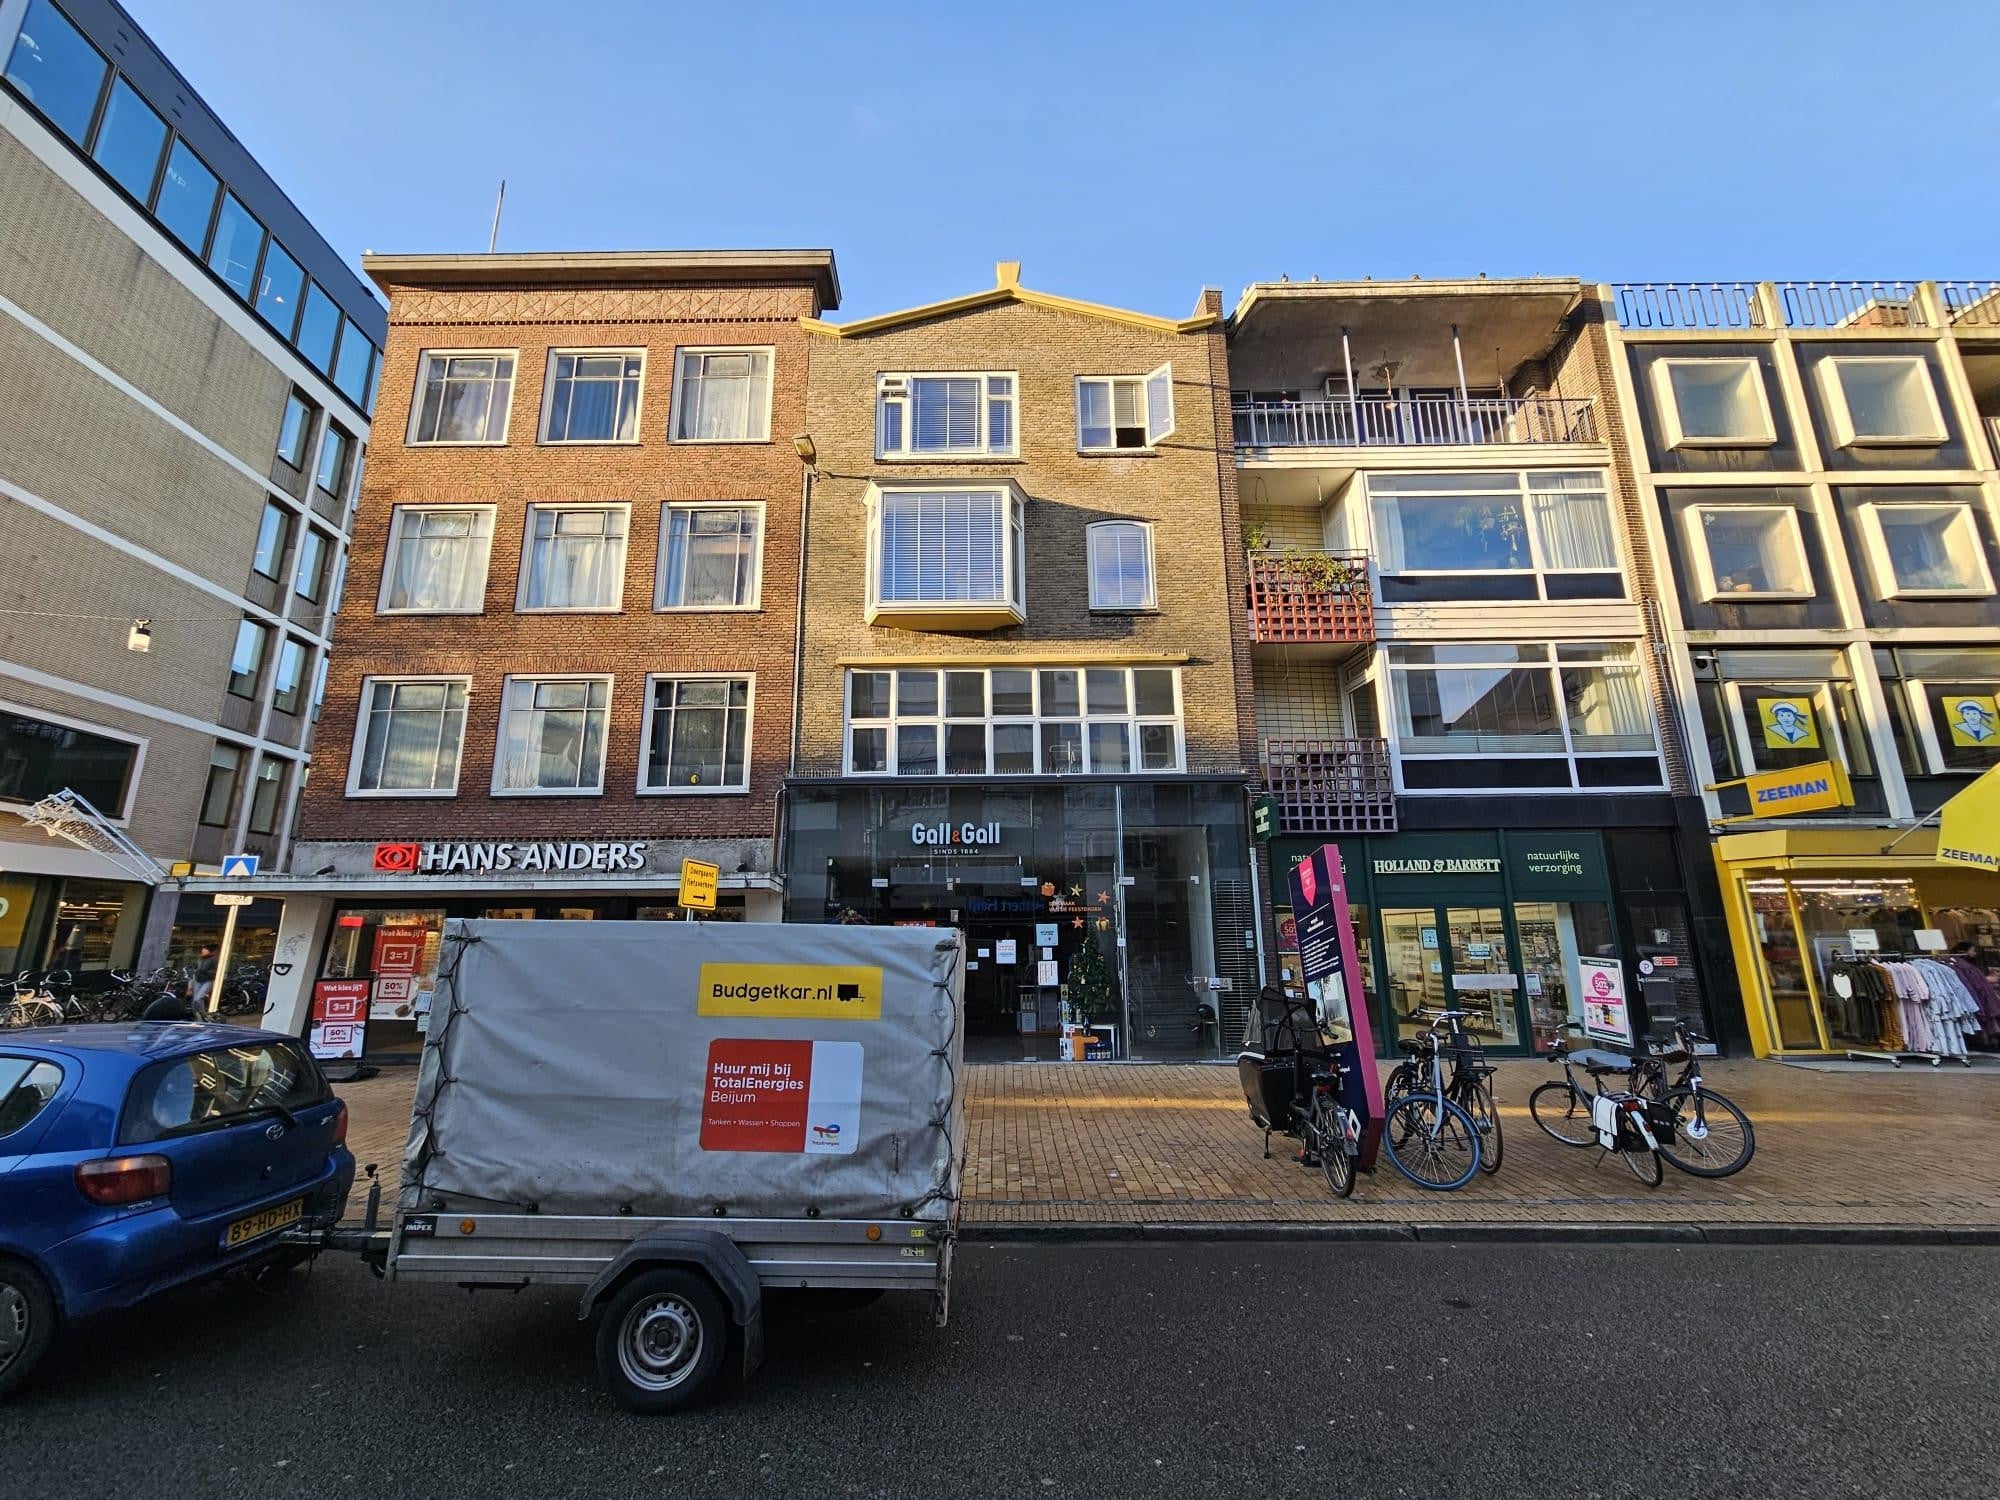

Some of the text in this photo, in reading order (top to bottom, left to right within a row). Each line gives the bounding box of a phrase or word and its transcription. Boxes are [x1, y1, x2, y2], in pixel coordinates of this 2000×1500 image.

[1756, 779, 1828, 803] ZEEMAN
[427, 843, 646, 870] HANS ANDERS
[1527, 851, 1580, 862] natuurlijke
[1374, 859, 1501, 874] HOLLAND & BARRETT
[1529, 863, 1583, 875] verzorging
[389, 951, 409, 960] 3=1
[385, 982, 404, 990] 50%
[712, 983, 833, 1003] Budgetkar.nl
[332, 1003, 350, 1011] 3=1
[714, 1063, 791, 1077] Huur mij bij
[712, 1076, 804, 1091] TotalEnergies
[710, 1090, 756, 1104] Beijum
[708, 1118, 800, 1129] Tanken Wassen Shoppen
[231, 1202, 301, 1241] 89-HD-HX
